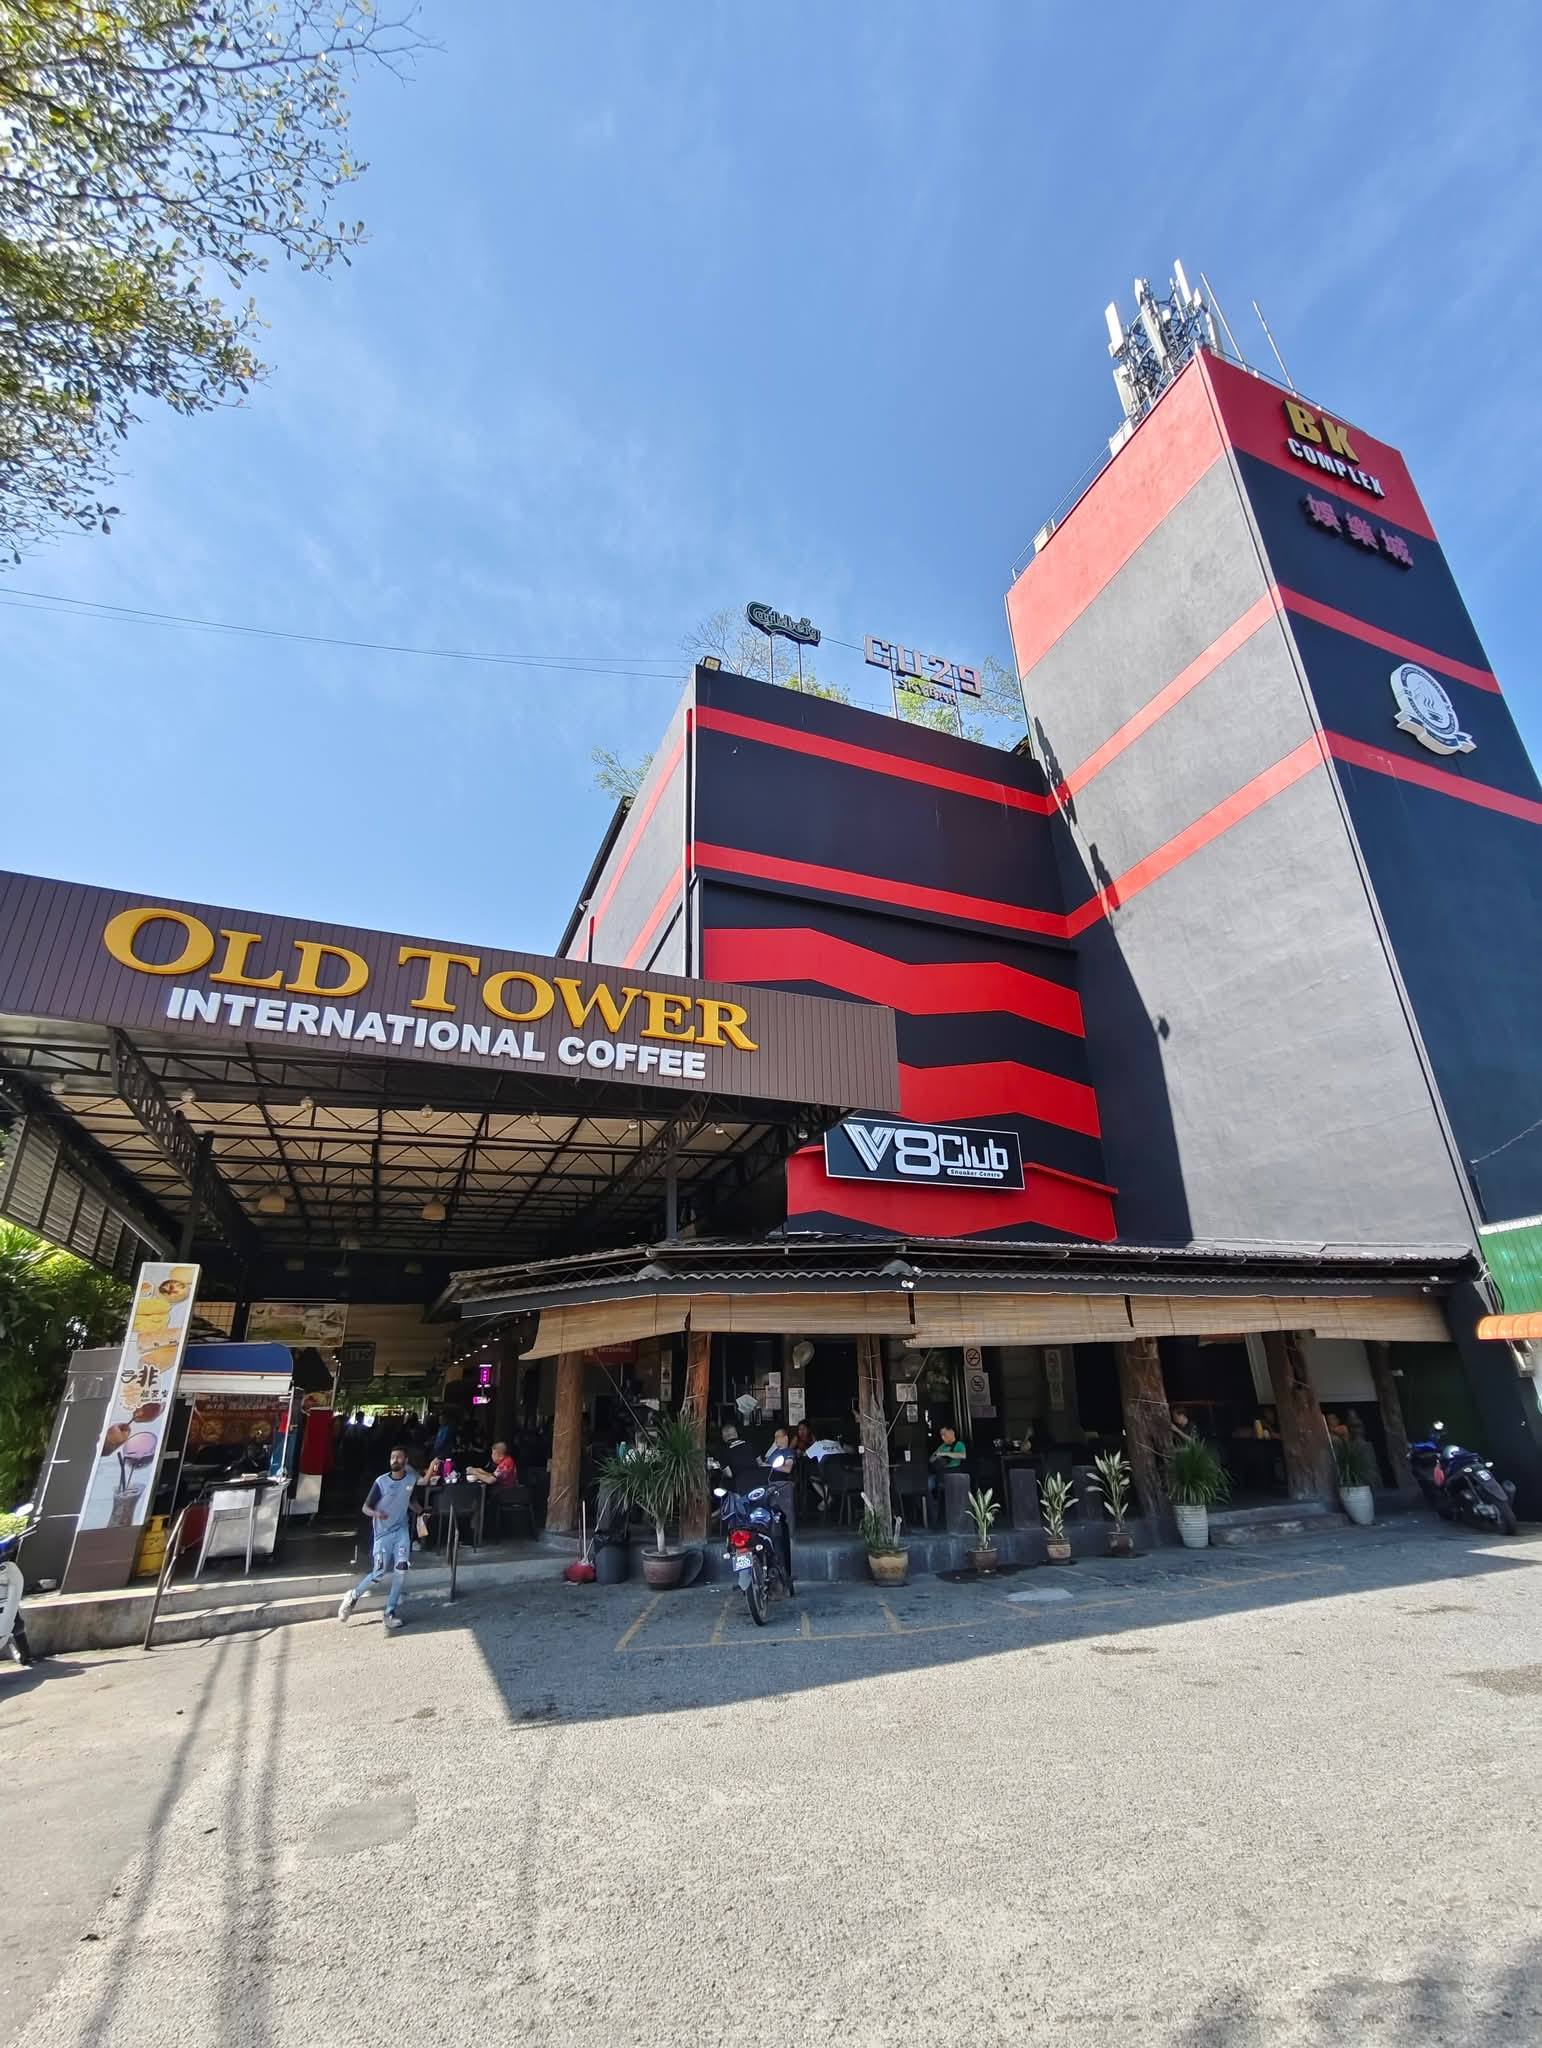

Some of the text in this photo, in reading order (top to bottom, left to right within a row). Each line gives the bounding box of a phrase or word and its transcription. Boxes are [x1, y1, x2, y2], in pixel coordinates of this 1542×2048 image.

[1285, 400, 1360, 464] BK
[1288, 438, 1386, 497] COMPLEX
[747, 601, 821, 645] Carlsberg
[103, 907, 759, 1051] OLD TOWER
[166, 986, 706, 1080] INTERNATIONAL COFFEE
